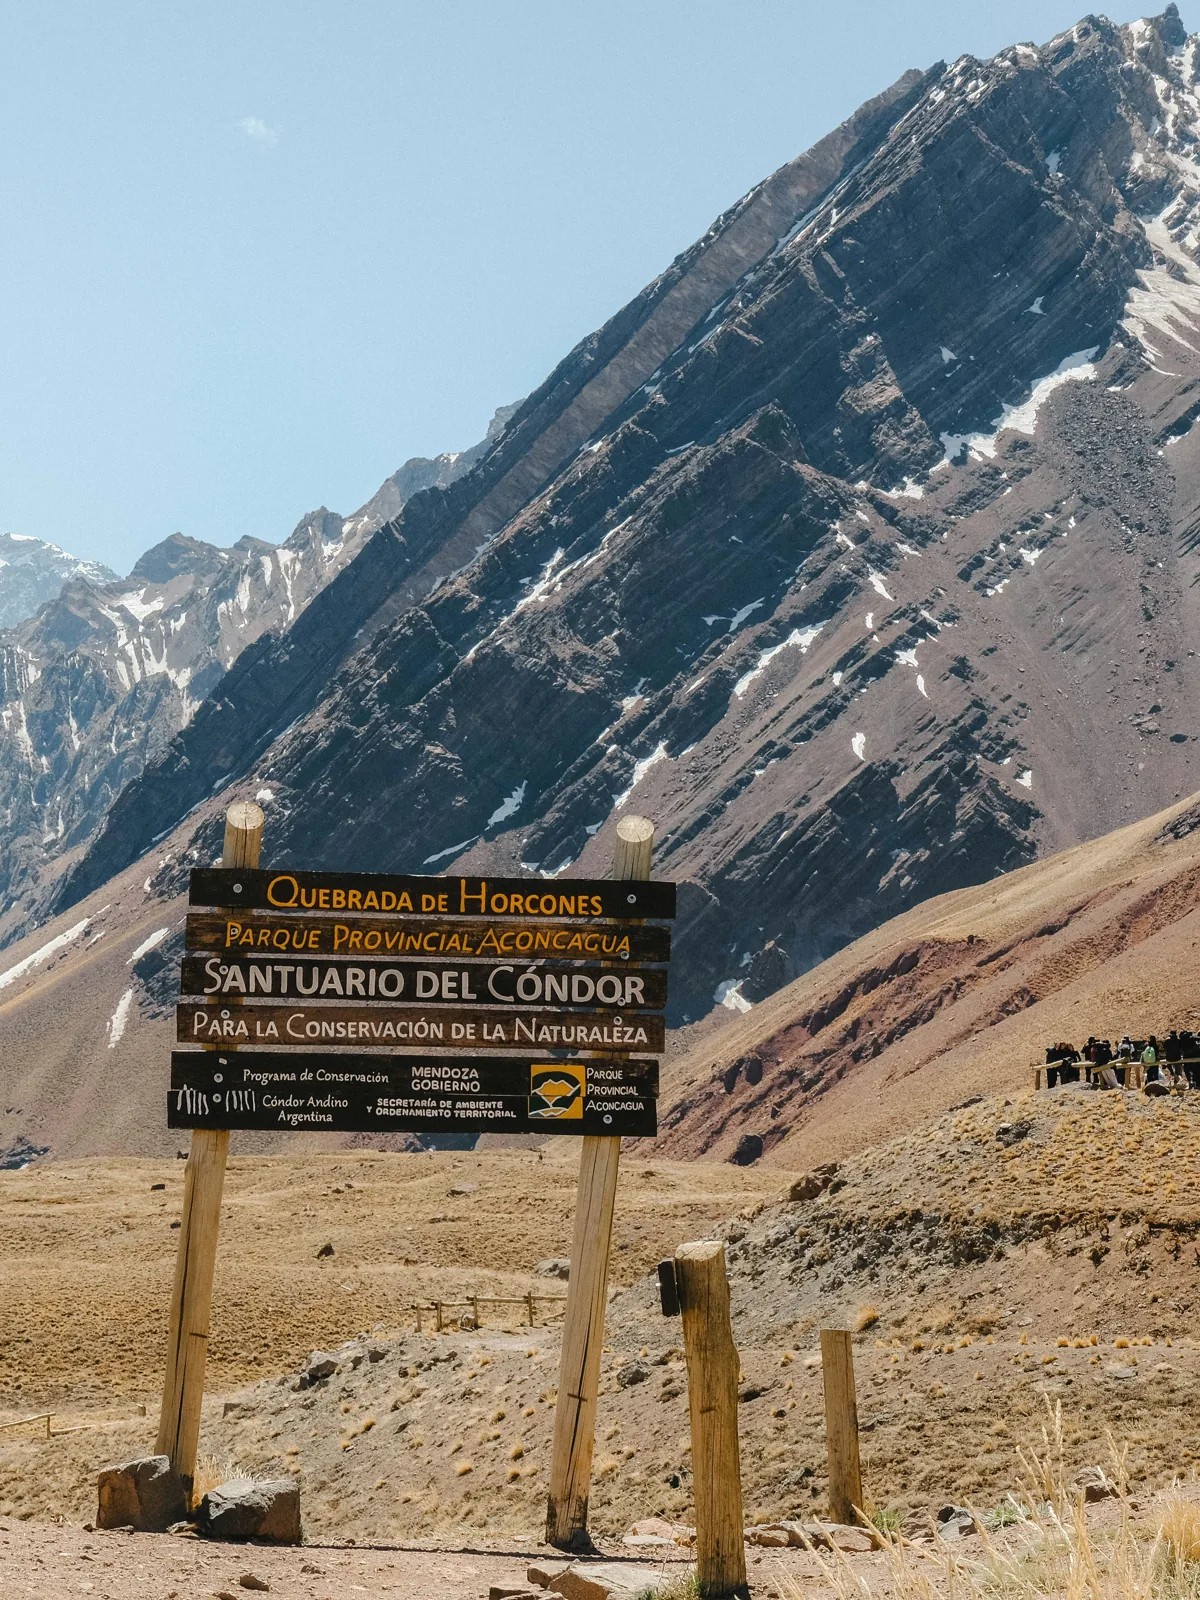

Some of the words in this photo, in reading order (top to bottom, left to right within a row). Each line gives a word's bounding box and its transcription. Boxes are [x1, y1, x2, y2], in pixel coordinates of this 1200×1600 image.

[267, 876, 413, 911] QUEBRADA
[421, 894, 448, 912] DE
[460, 879, 603, 915] HORCONES
[225, 922, 322, 950] PARQUE
[333, 924, 473, 951] PROVINCIAL
[475, 928, 630, 955] ACONCAGUA
[203, 958, 405, 997] SANTUARIO
[416, 970, 477, 1000] DEL
[487, 965, 645, 1004] CÓNDOR
[193, 1011, 249, 1036] PARA
[256, 1020, 279, 1037] LA
[286, 1013, 443, 1039] CONSERVACIÓN
[451, 1023, 475, 1040] DE
[483, 1023, 506, 1041] LA
[514, 1017, 648, 1044] NATURALEZA
[243, 1069, 296, 1085] Programa
[300, 1068, 313, 1081] de
[316, 1069, 389, 1083] Conservación
[412, 1066, 479, 1080] MENDOZA
[586, 1067, 623, 1080] PARQUE
[411, 1079, 481, 1093] GOBIERNO
[586, 1083, 639, 1096] PROVINCIAL
[262, 1095, 306, 1108] Cóndor
[306, 1095, 349, 1108] Andino
[377, 1097, 437, 1108] SECRETARÍA
[439, 1100, 453, 1109] DE
[455, 1101, 503, 1109] AMBIENTE
[585, 1099, 645, 1111] ACONCAGUA
[277, 1111, 334, 1126] Argentina
[375, 1107, 451, 1118] ORDENAMIENTO
[453, 1109, 517, 1119] TERRITORIAL
